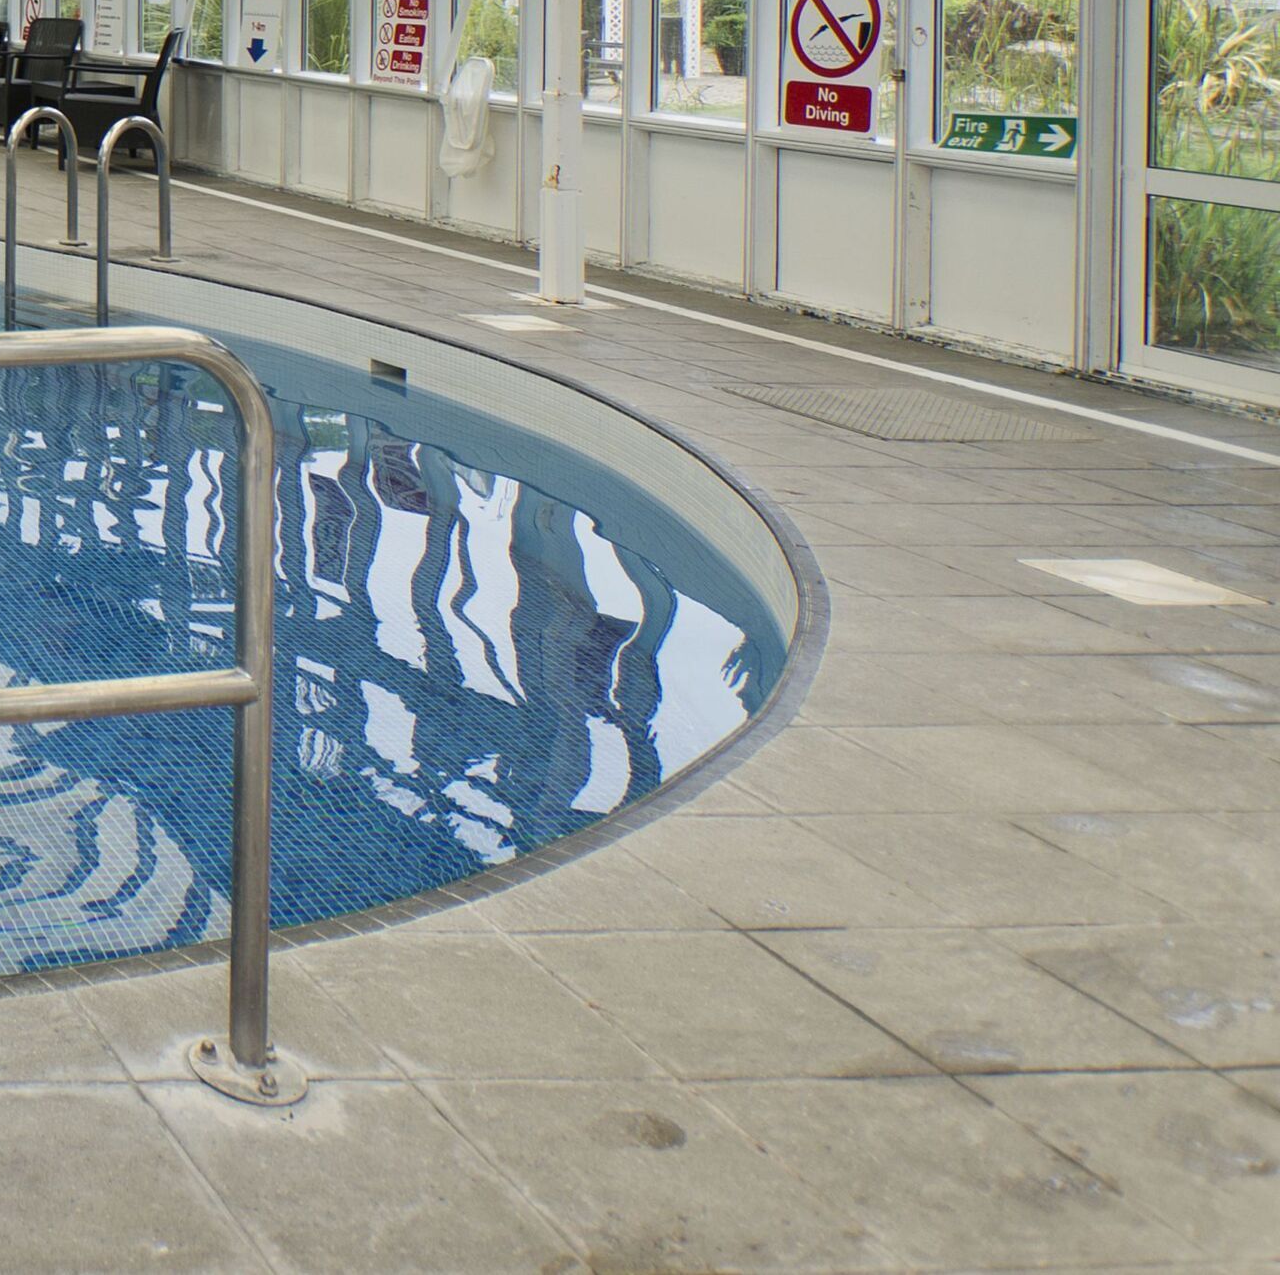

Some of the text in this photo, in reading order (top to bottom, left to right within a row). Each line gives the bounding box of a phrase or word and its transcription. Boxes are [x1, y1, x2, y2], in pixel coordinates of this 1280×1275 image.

[398, 7, 427, 20] Smoking
[405, 25, 416, 34] No
[398, 33, 420, 46] Eating
[402, 52, 413, 61] No
[392, 60, 420, 74] Drinking
[818, 86, 839, 104] No
[805, 104, 850, 127] Diving
[954, 117, 989, 134] Fire
[947, 135, 983, 148] exit
